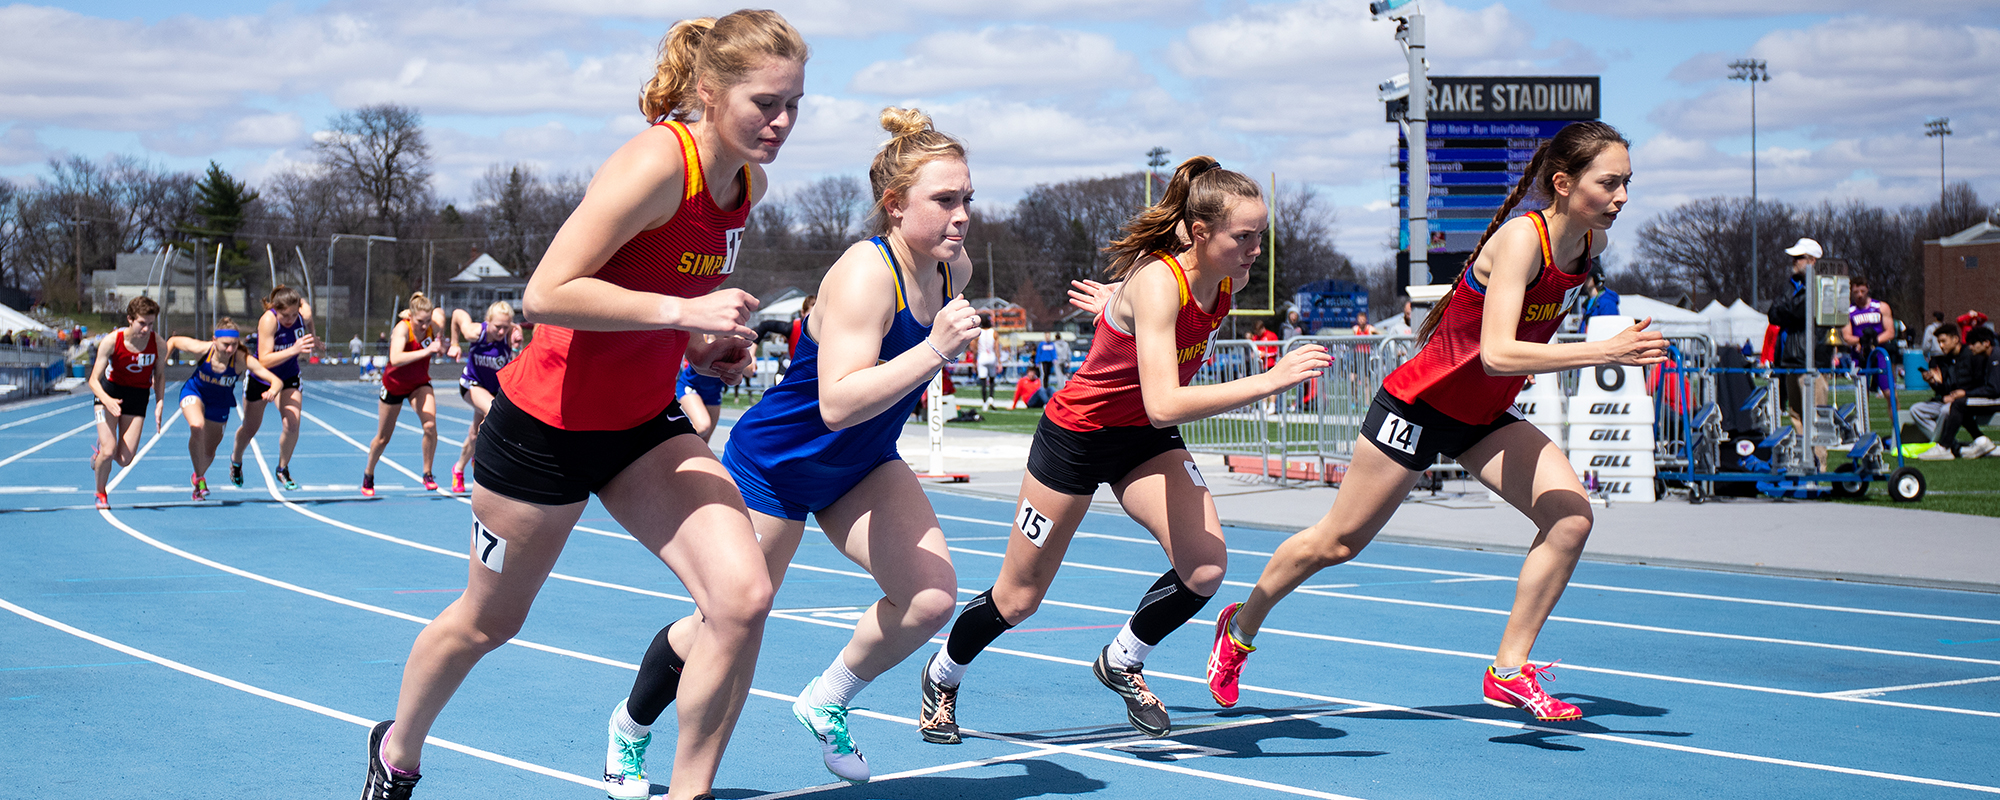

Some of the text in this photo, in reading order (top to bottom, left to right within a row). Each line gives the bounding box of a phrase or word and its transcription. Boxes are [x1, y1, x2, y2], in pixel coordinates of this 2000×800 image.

[1491, 84, 1593, 112] STADIUM
[1448, 124, 1471, 134] Meter
[1473, 124, 1489, 134] Run
[142, 354, 152, 364] 11
[224, 376, 234, 387] 10
[1589, 403, 1631, 415] GILL
[1388, 418, 1414, 451] 14
[1589, 429, 1631, 441] GILL
[1589, 455, 1631, 467] GILL
[1022, 506, 1047, 541] 15
[474, 520, 499, 564] 17
